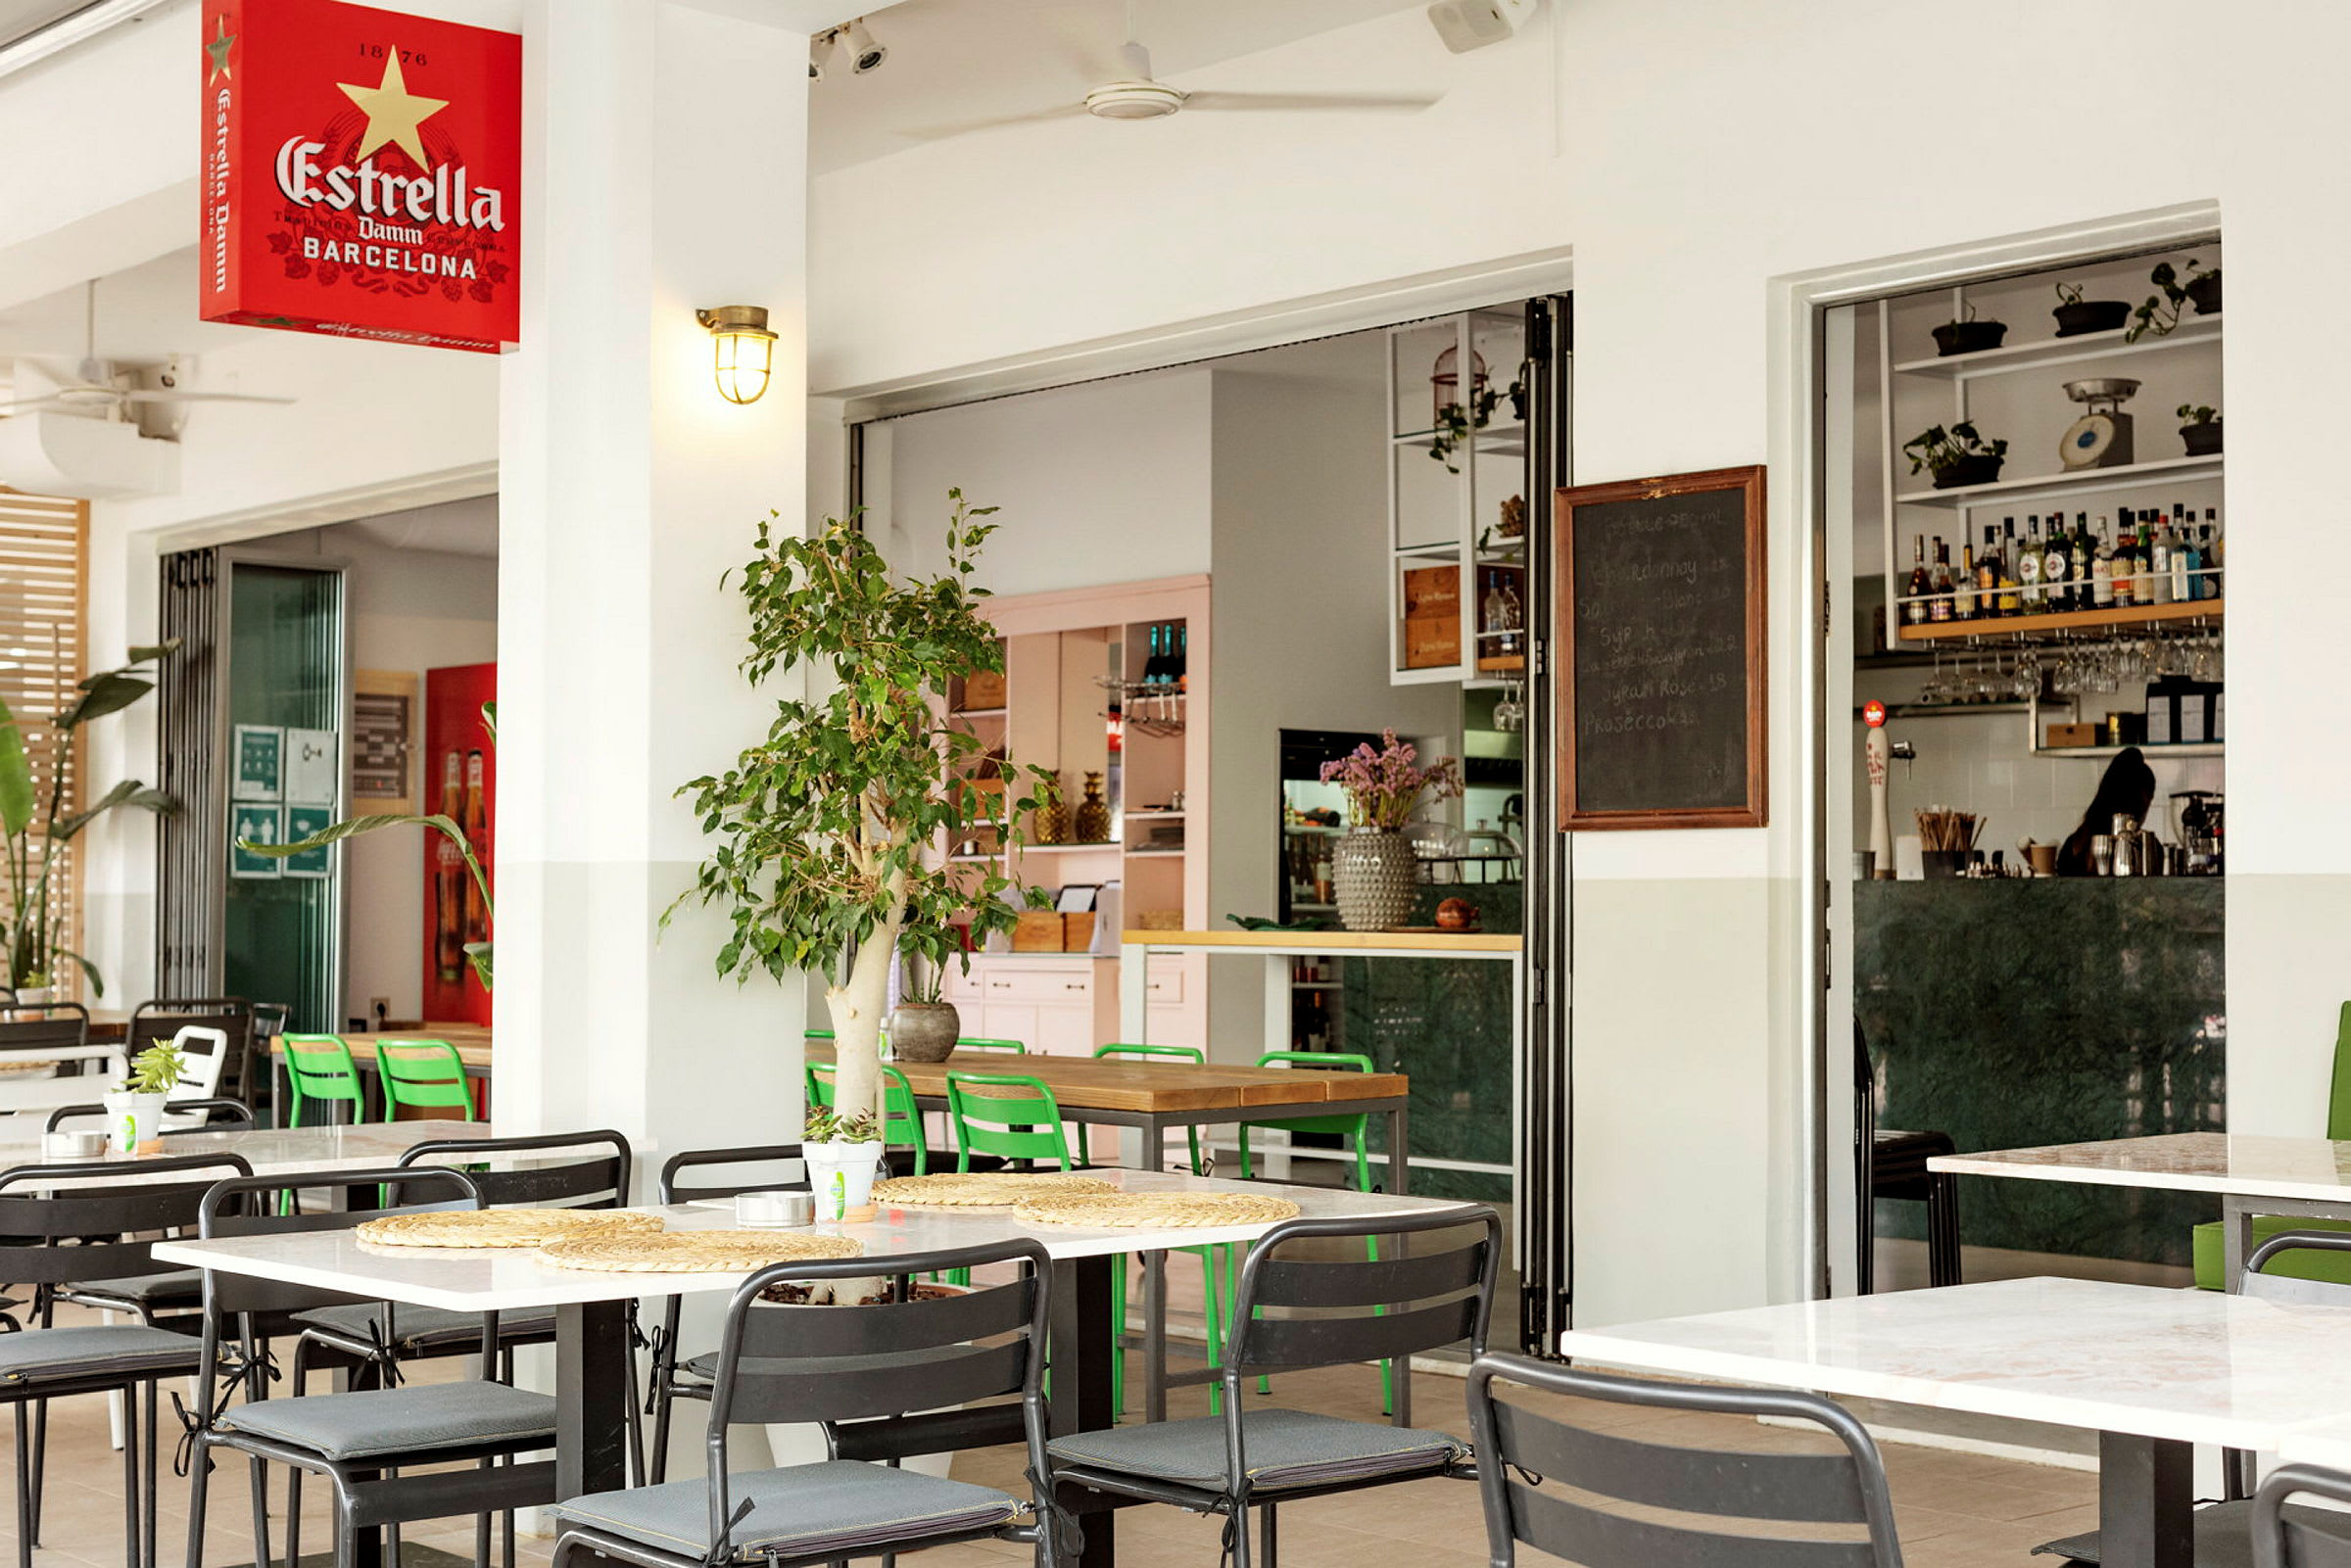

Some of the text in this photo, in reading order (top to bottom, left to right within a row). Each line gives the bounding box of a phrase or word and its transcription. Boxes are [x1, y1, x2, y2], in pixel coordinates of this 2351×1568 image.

[216, 88, 231, 293] Estrella Damm
[274, 135, 505, 233] Estrella
[303, 236, 478, 280] BARCELONA
[357, 214, 423, 245] Damm
